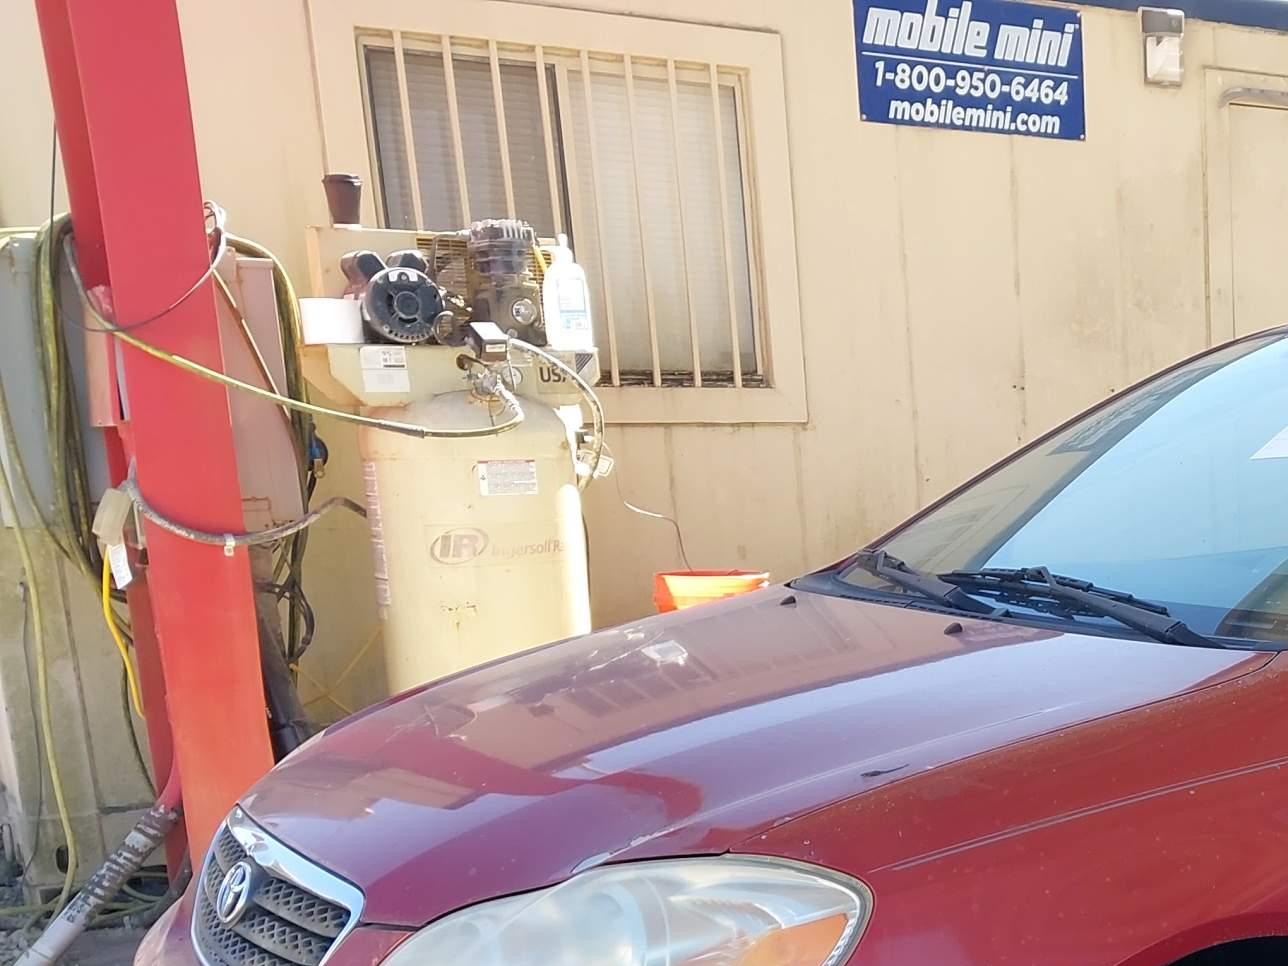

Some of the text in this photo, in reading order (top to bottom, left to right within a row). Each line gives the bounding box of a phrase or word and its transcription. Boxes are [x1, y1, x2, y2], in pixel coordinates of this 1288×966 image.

[862, 0, 1074, 67] mobile mini
[874, 60, 1069, 106] 1-800-950-6464
[888, 98, 1061, 134] mobilemini.com
[539, 366, 567, 383] US
